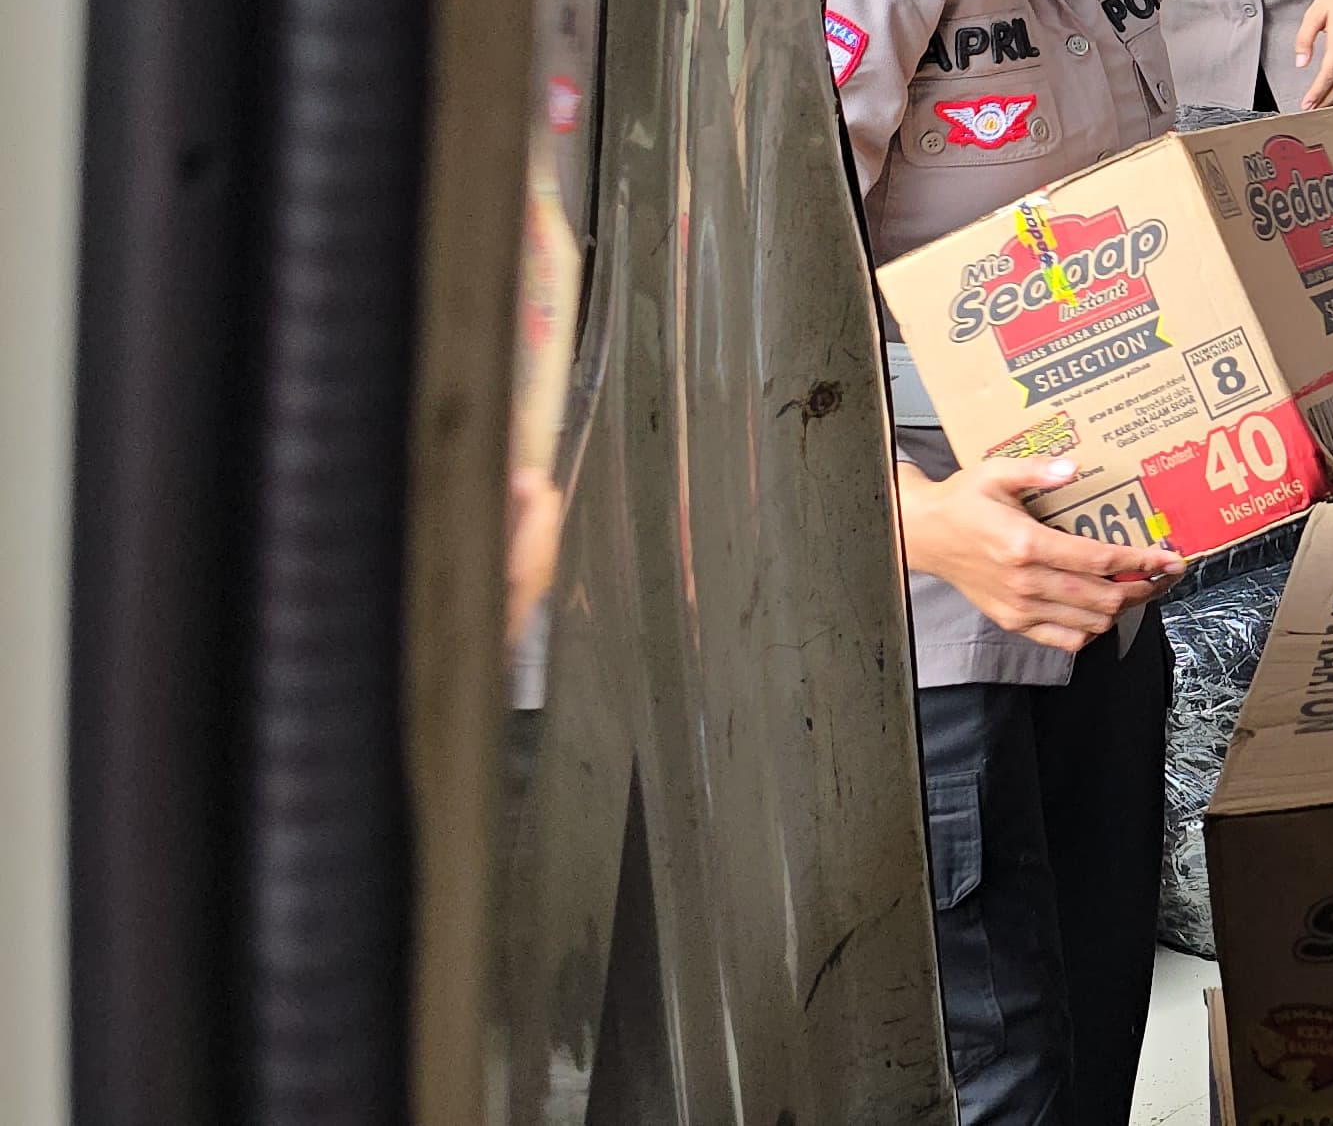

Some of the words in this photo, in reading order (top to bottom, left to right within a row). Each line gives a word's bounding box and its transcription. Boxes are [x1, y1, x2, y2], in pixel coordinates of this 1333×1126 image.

[1244, 152, 1276, 183] Mie
[961, 254, 1014, 291] Mie
[1015, 347, 1048, 368] JELAS
[1049, 330, 1092, 352] TERASA
[1093, 304, 1151, 334] SEDAPNYA
[1211, 356, 1246, 395] 8
[1205, 414, 1288, 496] 40
[1219, 478, 1305, 525] bks/packs
